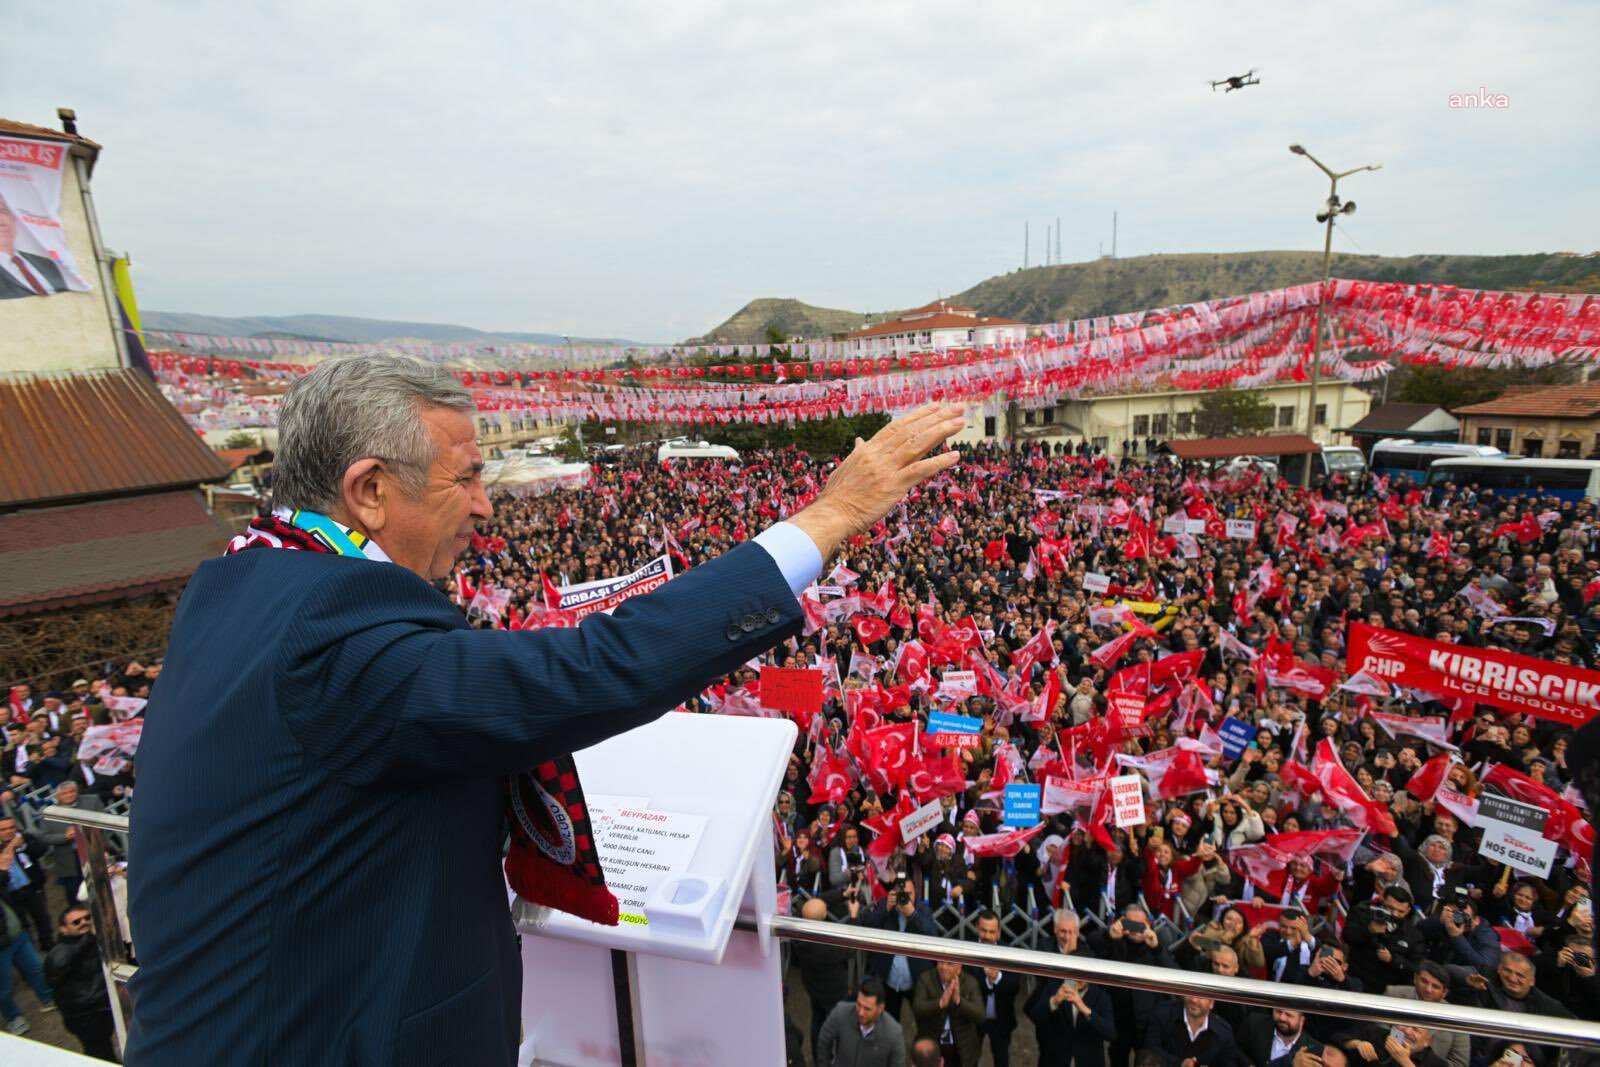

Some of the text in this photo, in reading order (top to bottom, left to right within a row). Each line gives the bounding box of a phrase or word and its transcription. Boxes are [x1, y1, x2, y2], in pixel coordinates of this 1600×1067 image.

[38, 144, 56, 166] İŞ
[559, 587, 610, 608] KIRBAŞI
[1363, 656, 1406, 678] CHP
[1428, 649, 1600, 710] KIBRISCIK
[1443, 676, 1585, 719] İLÇE ÖRGÜTÜ
[958, 735, 971, 748] ÇOK
[620, 810, 668, 822] BEYPAZARI
[609, 832, 639, 841] VEREBİLİR
[612, 823, 690, 840] ŞEFFAF, KATILIMCI, HESAP
[603, 842, 656, 856] 4000 İHALE CANLI
[1485, 840, 1547, 870] HOŞ GELDİN
[609, 858, 640, 867] KURUŞUN
[640, 862, 671, 872] HESABINI
[633, 885, 648, 893] GİBİ
